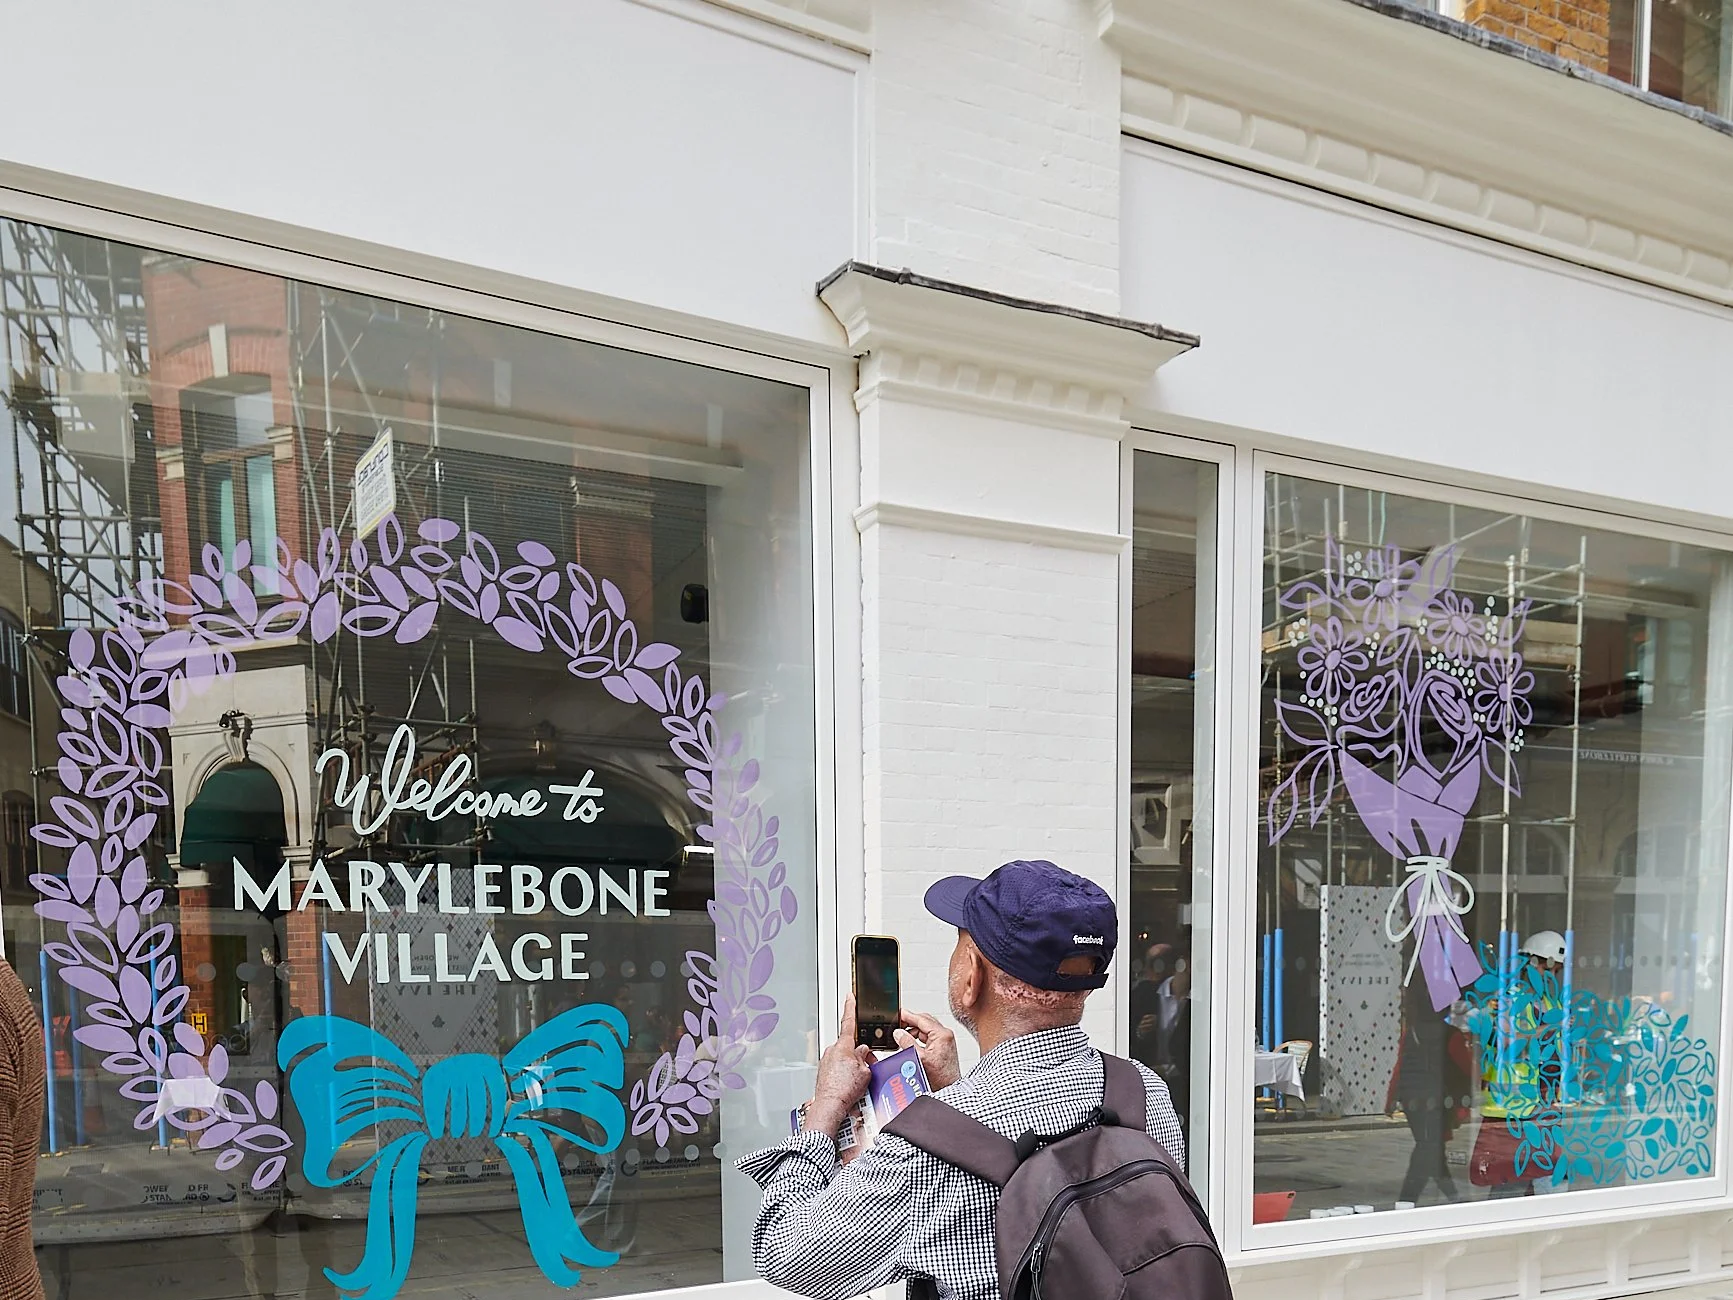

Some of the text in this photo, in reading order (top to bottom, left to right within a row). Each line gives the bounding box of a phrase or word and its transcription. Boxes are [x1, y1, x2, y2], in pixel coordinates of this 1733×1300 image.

[315, 724, 605, 836] Welcome to
[233, 856, 671, 918] MARYLEBONE
[323, 930, 591, 985] VILLAGE
[1072, 934, 1104, 946] facebook
